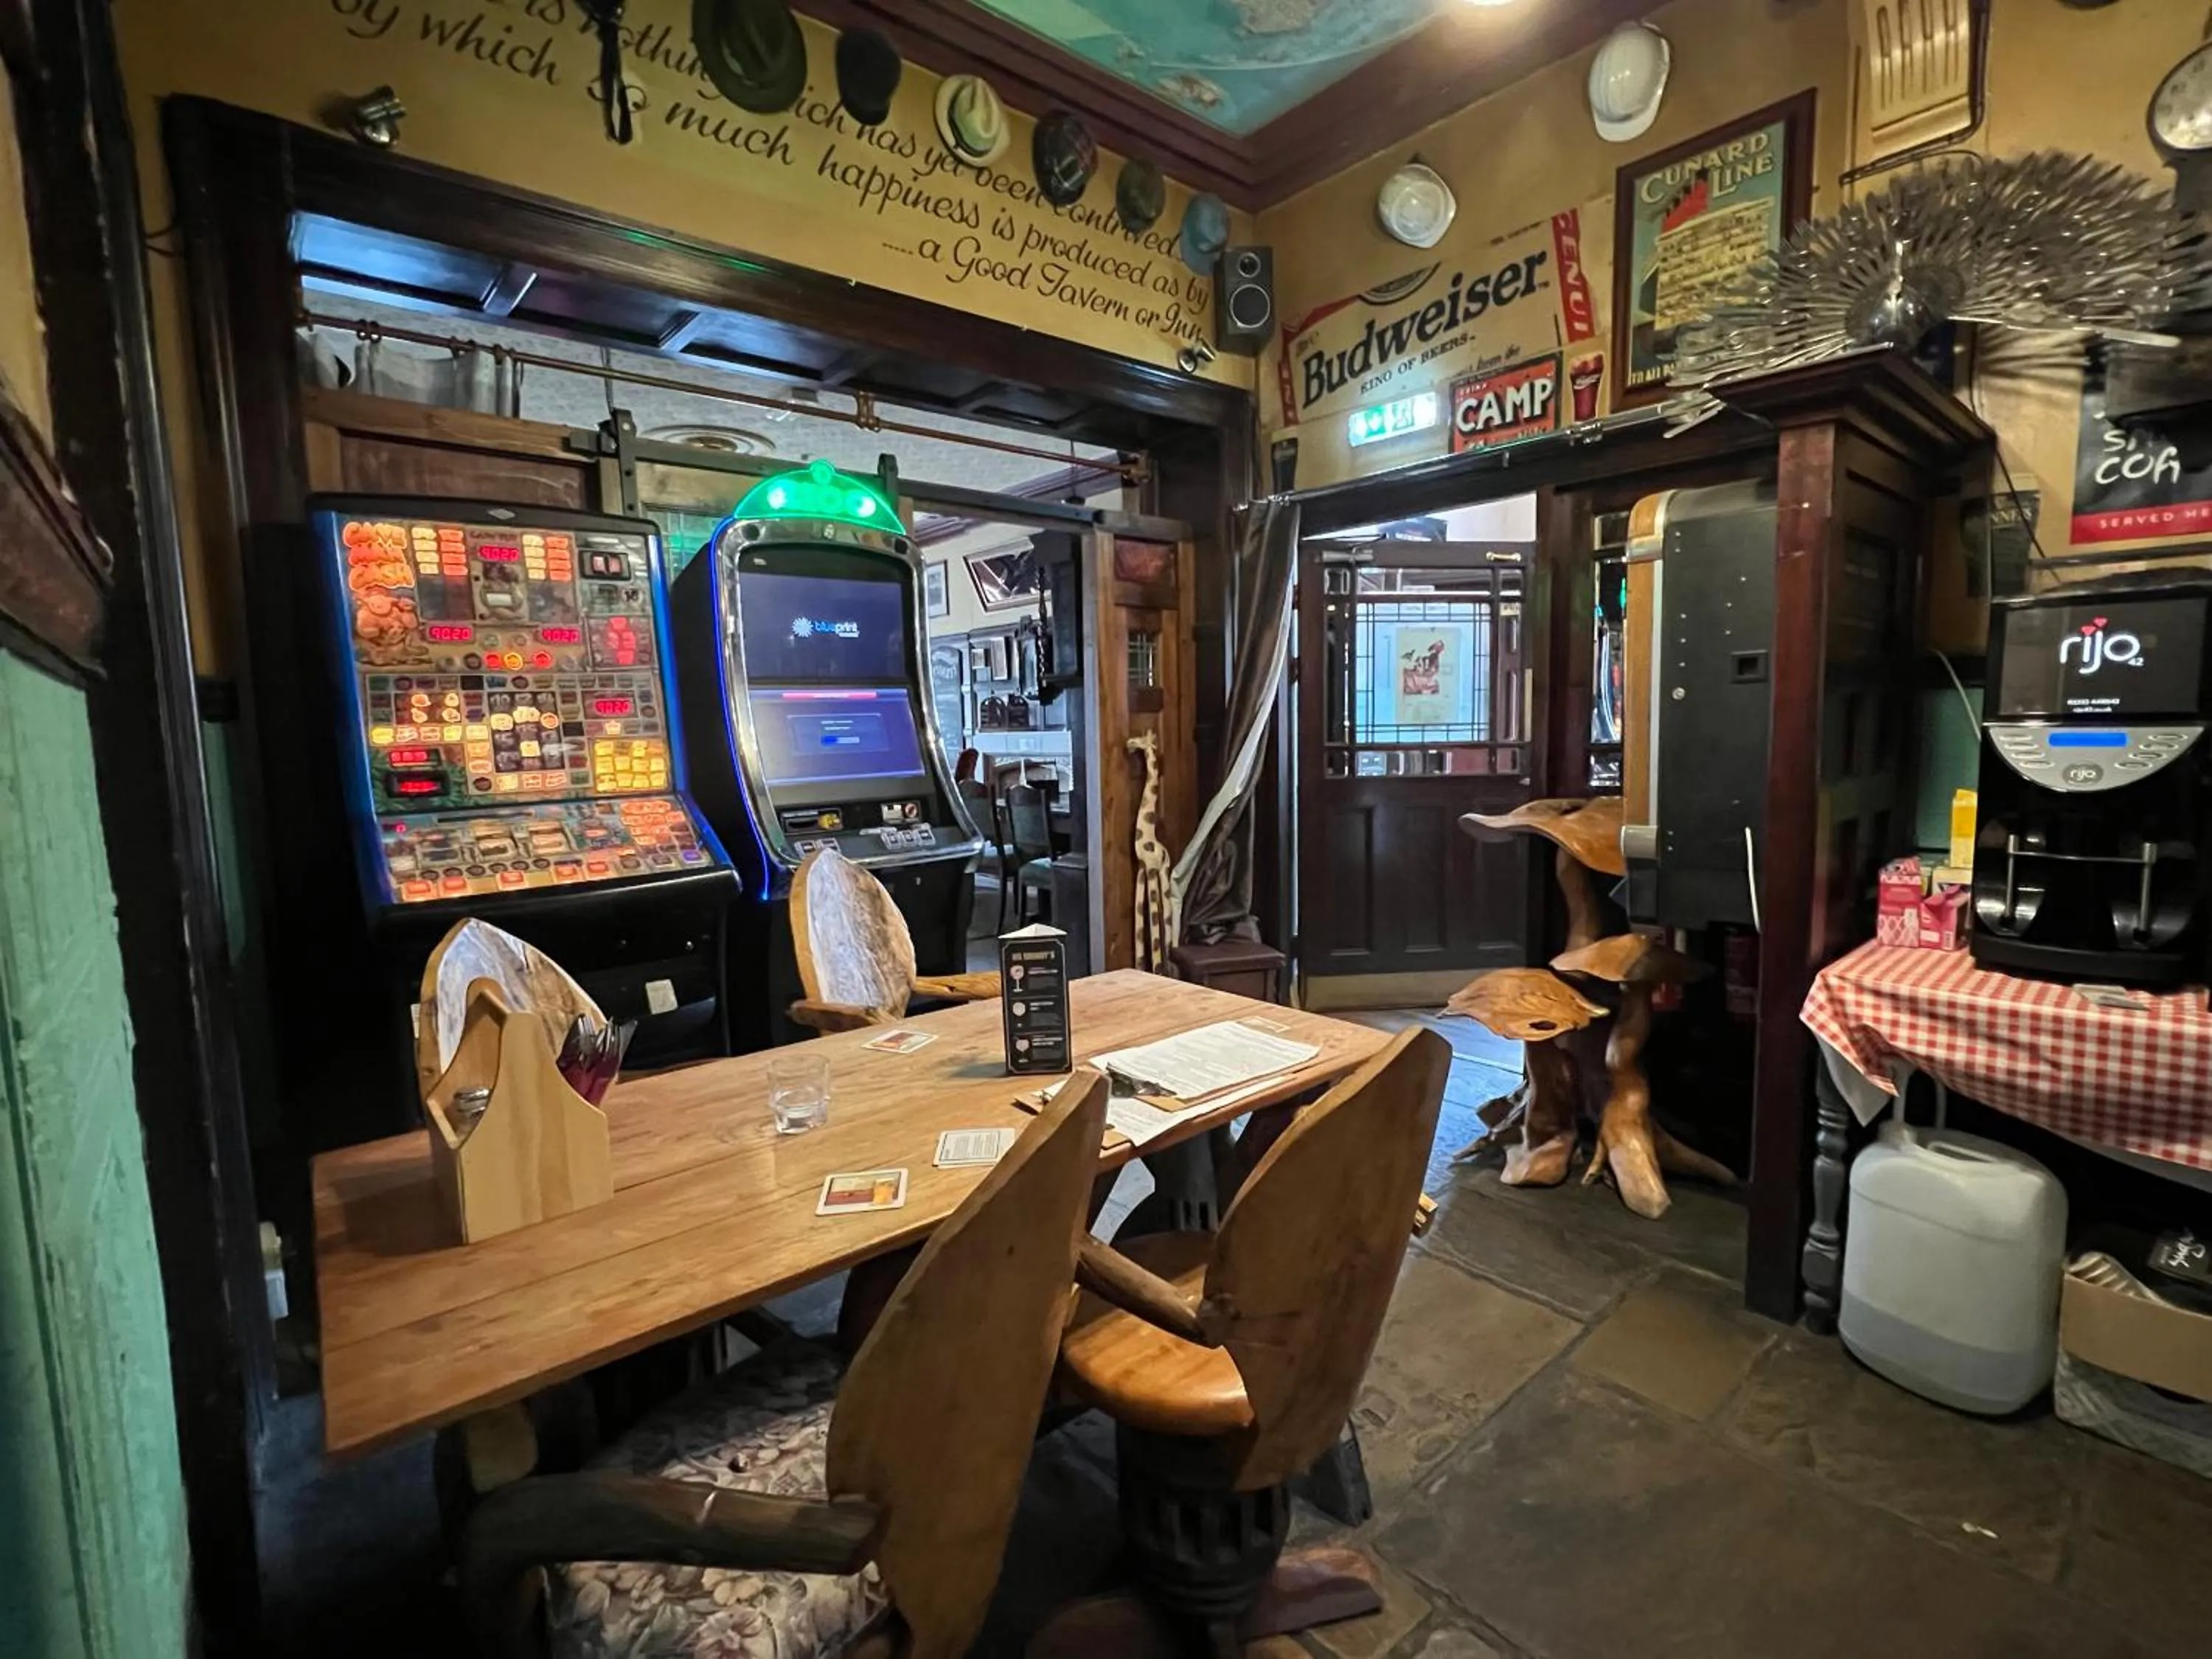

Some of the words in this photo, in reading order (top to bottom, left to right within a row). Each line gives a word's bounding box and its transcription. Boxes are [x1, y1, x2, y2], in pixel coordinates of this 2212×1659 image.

[795, 86, 846, 134] ich
[420, 13, 562, 86] which
[666, 102, 794, 165] much
[818, 144, 980, 229] happiness
[992, 207, 1015, 241] is
[1018, 223, 1152, 287] produced
[1153, 274, 1180, 297] as
[1185, 277, 1210, 316] by
[1641, 132, 1768, 204] CUNARD
[1712, 152, 1773, 198] LINE
[946, 235, 1033, 290] Good
[1037, 262, 1129, 321] Tavern
[1135, 306, 1159, 328] or
[1302, 251, 1547, 410] Budweiser
[1398, 359, 1416, 374] OF
[1421, 335, 1468, 365] BEERS
[1456, 378, 1553, 433] CAMP
[2099, 512, 2174, 529] SERVED
[2059, 617, 2140, 675] rijo
[2070, 767, 2096, 782] rijo
